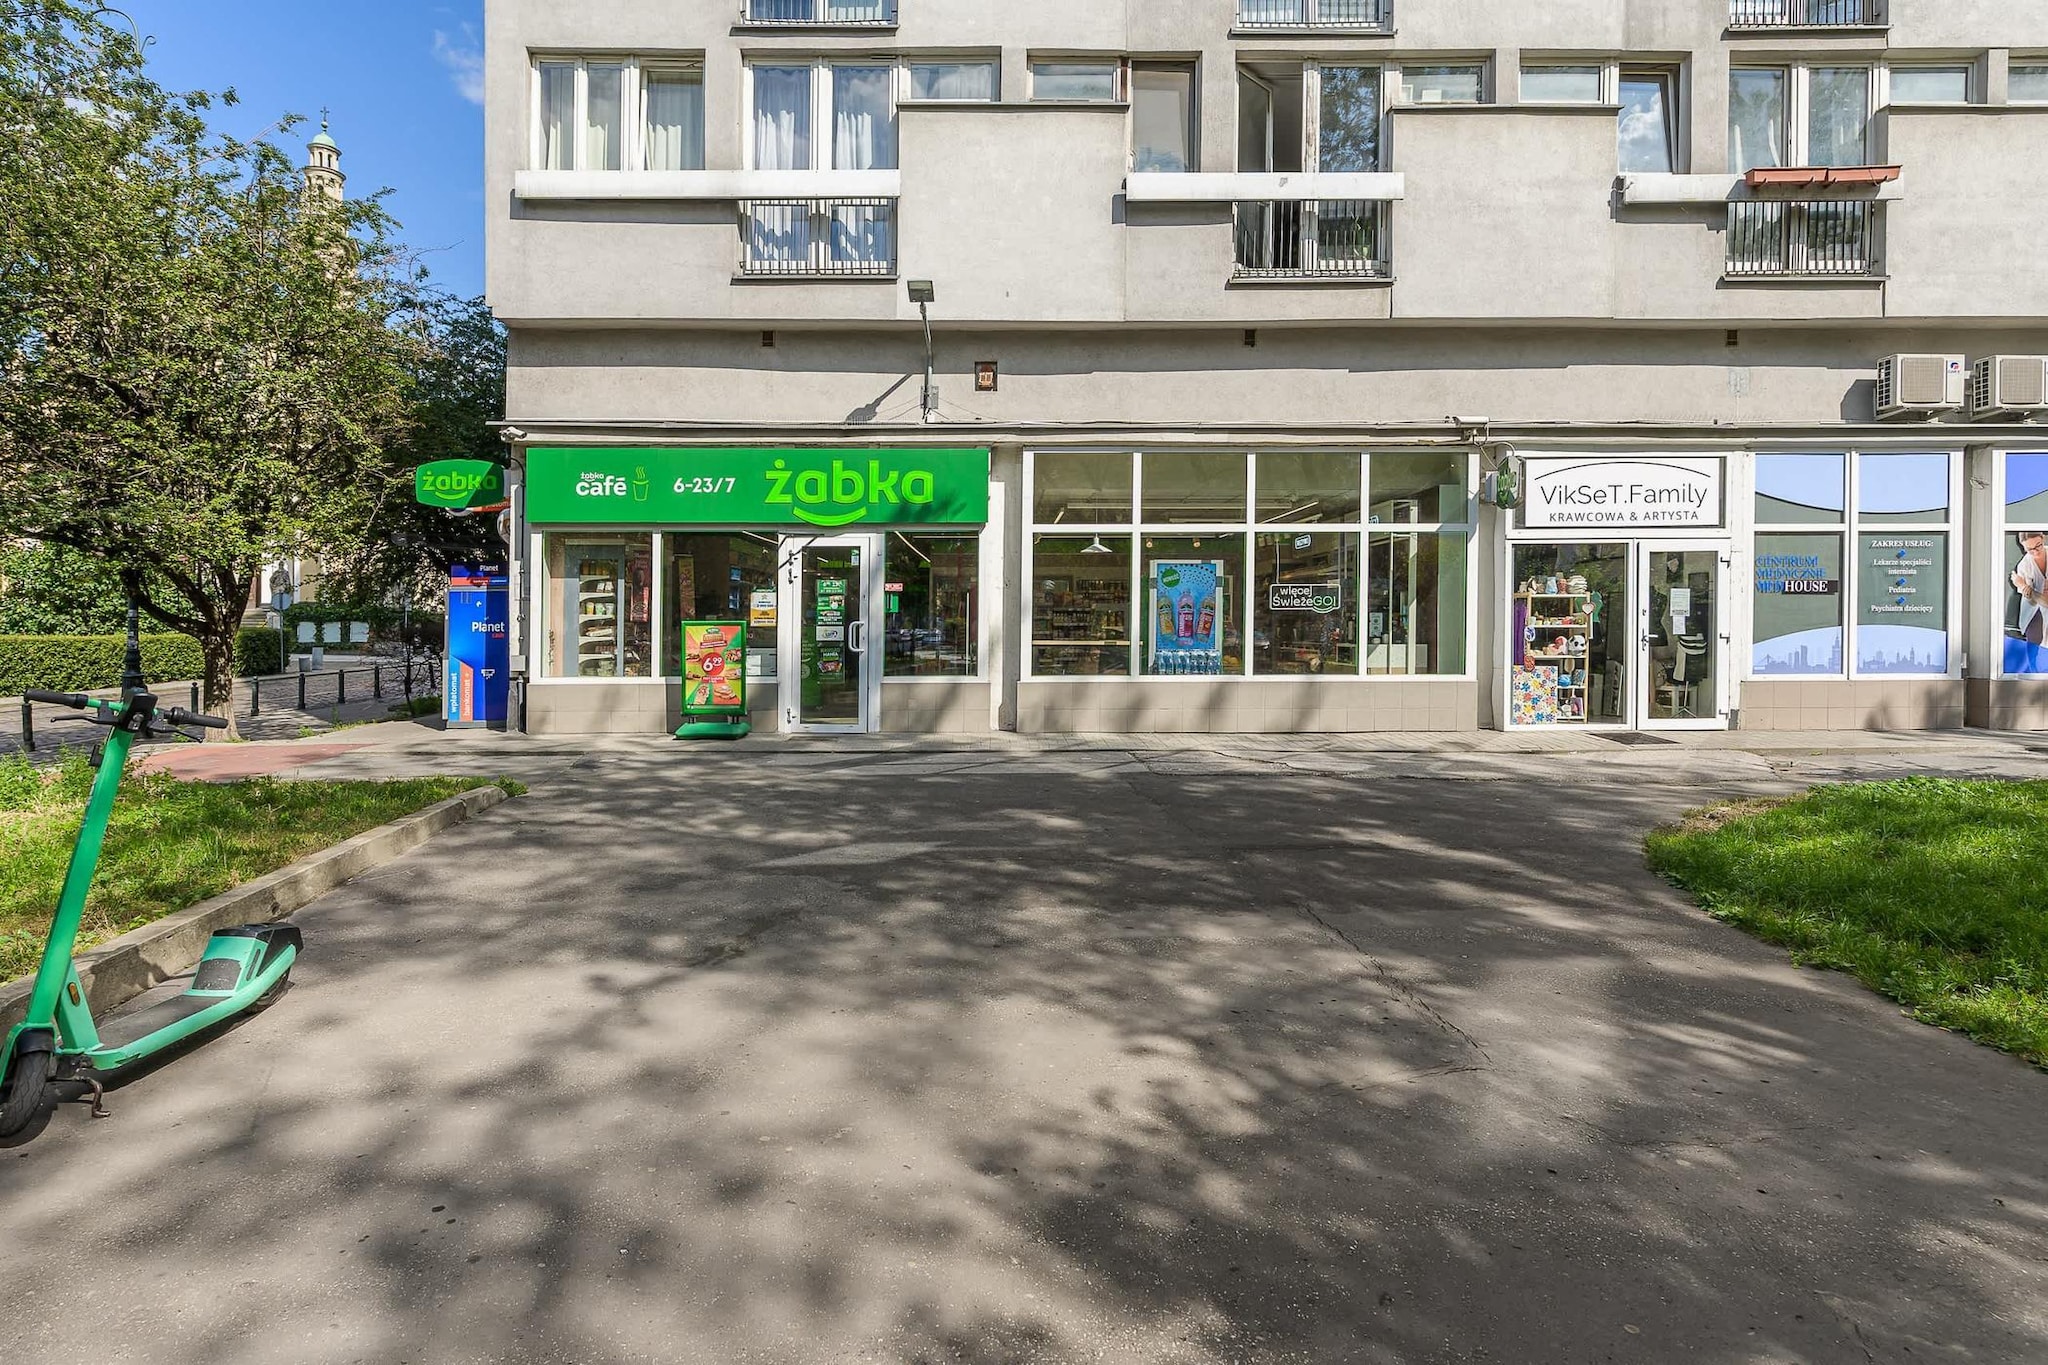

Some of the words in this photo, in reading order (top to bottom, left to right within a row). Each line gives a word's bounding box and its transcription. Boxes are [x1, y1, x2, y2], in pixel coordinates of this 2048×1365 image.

[422, 470, 497, 491] żabka
[575, 475, 627, 496] café
[673, 477, 736, 493] 6-23/7
[764, 458, 934, 504] żabka
[1540, 483, 1708, 509] VikSeT.Family
[1549, 511, 1625, 522] KRAWCOWA
[1629, 511, 1638, 521] &
[1643, 510, 1699, 521] ARTYSTA
[1754, 554, 1819, 567] CENTRUM
[1873, 558, 1898, 566] Lekarze
[471, 621, 505, 632] Planet
